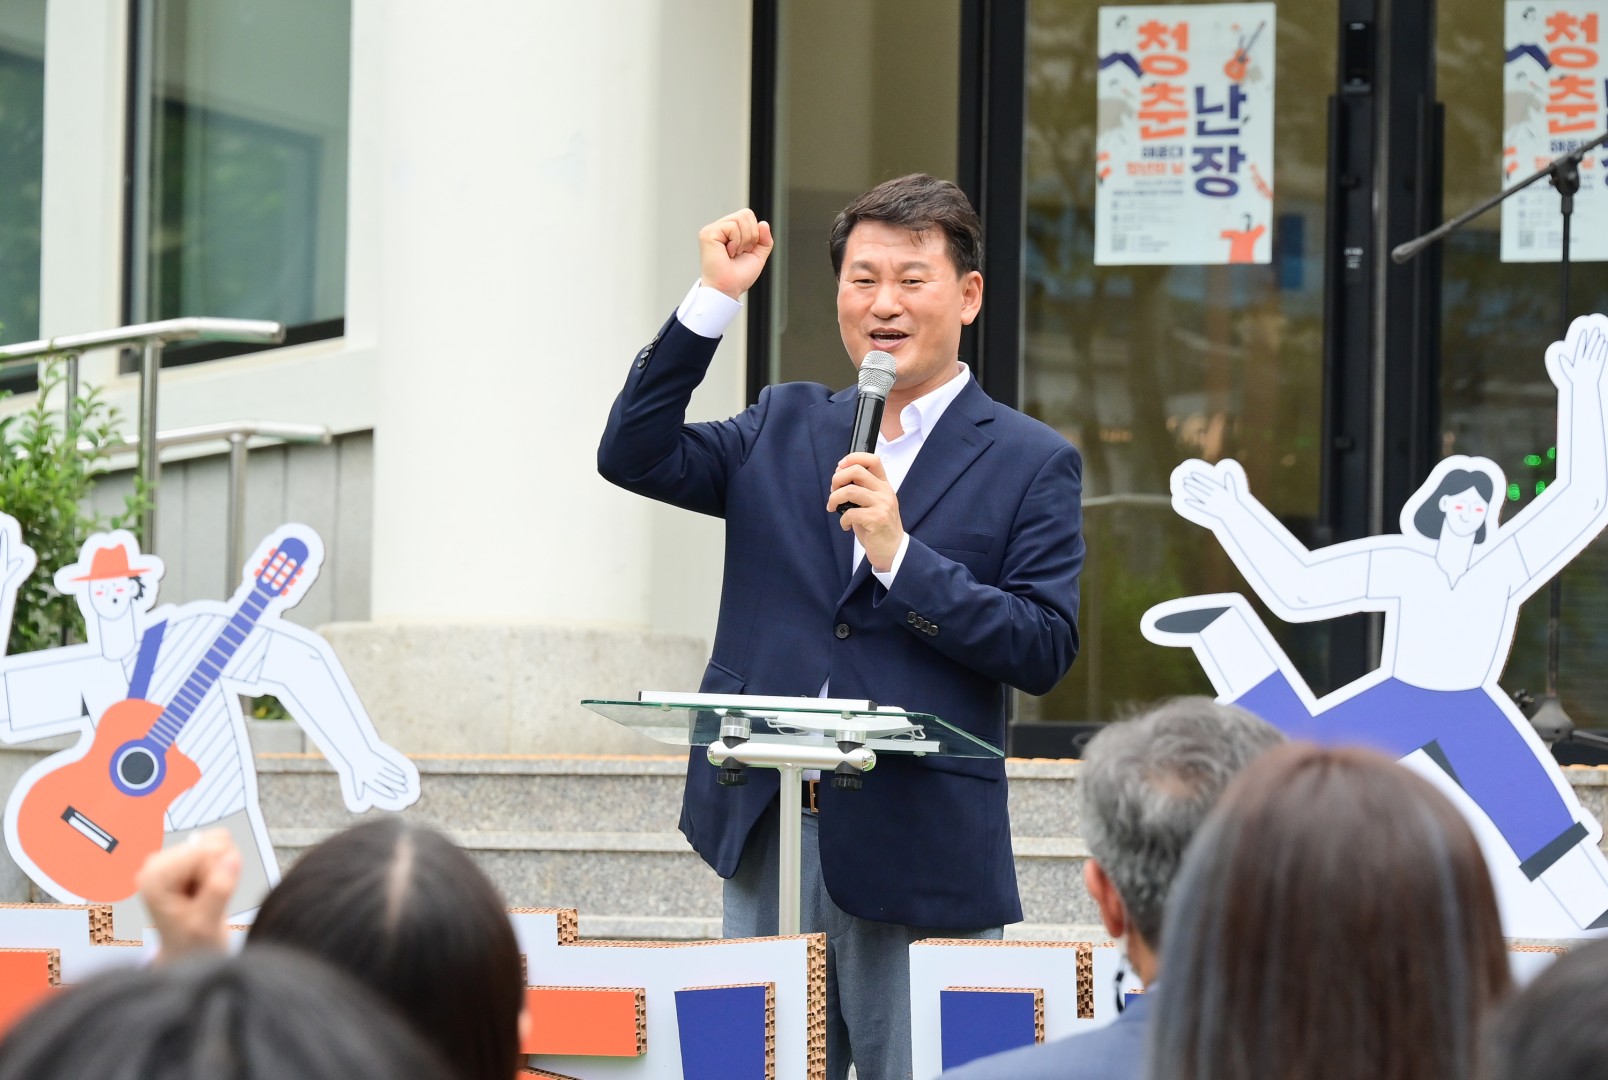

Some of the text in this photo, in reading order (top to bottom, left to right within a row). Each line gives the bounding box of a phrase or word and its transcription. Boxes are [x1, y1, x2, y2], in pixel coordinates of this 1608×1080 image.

[1137, 20, 1189, 139] 청춘
[1544, 10, 1599, 135] 청춘
[1191, 84, 1247, 197] 난장
